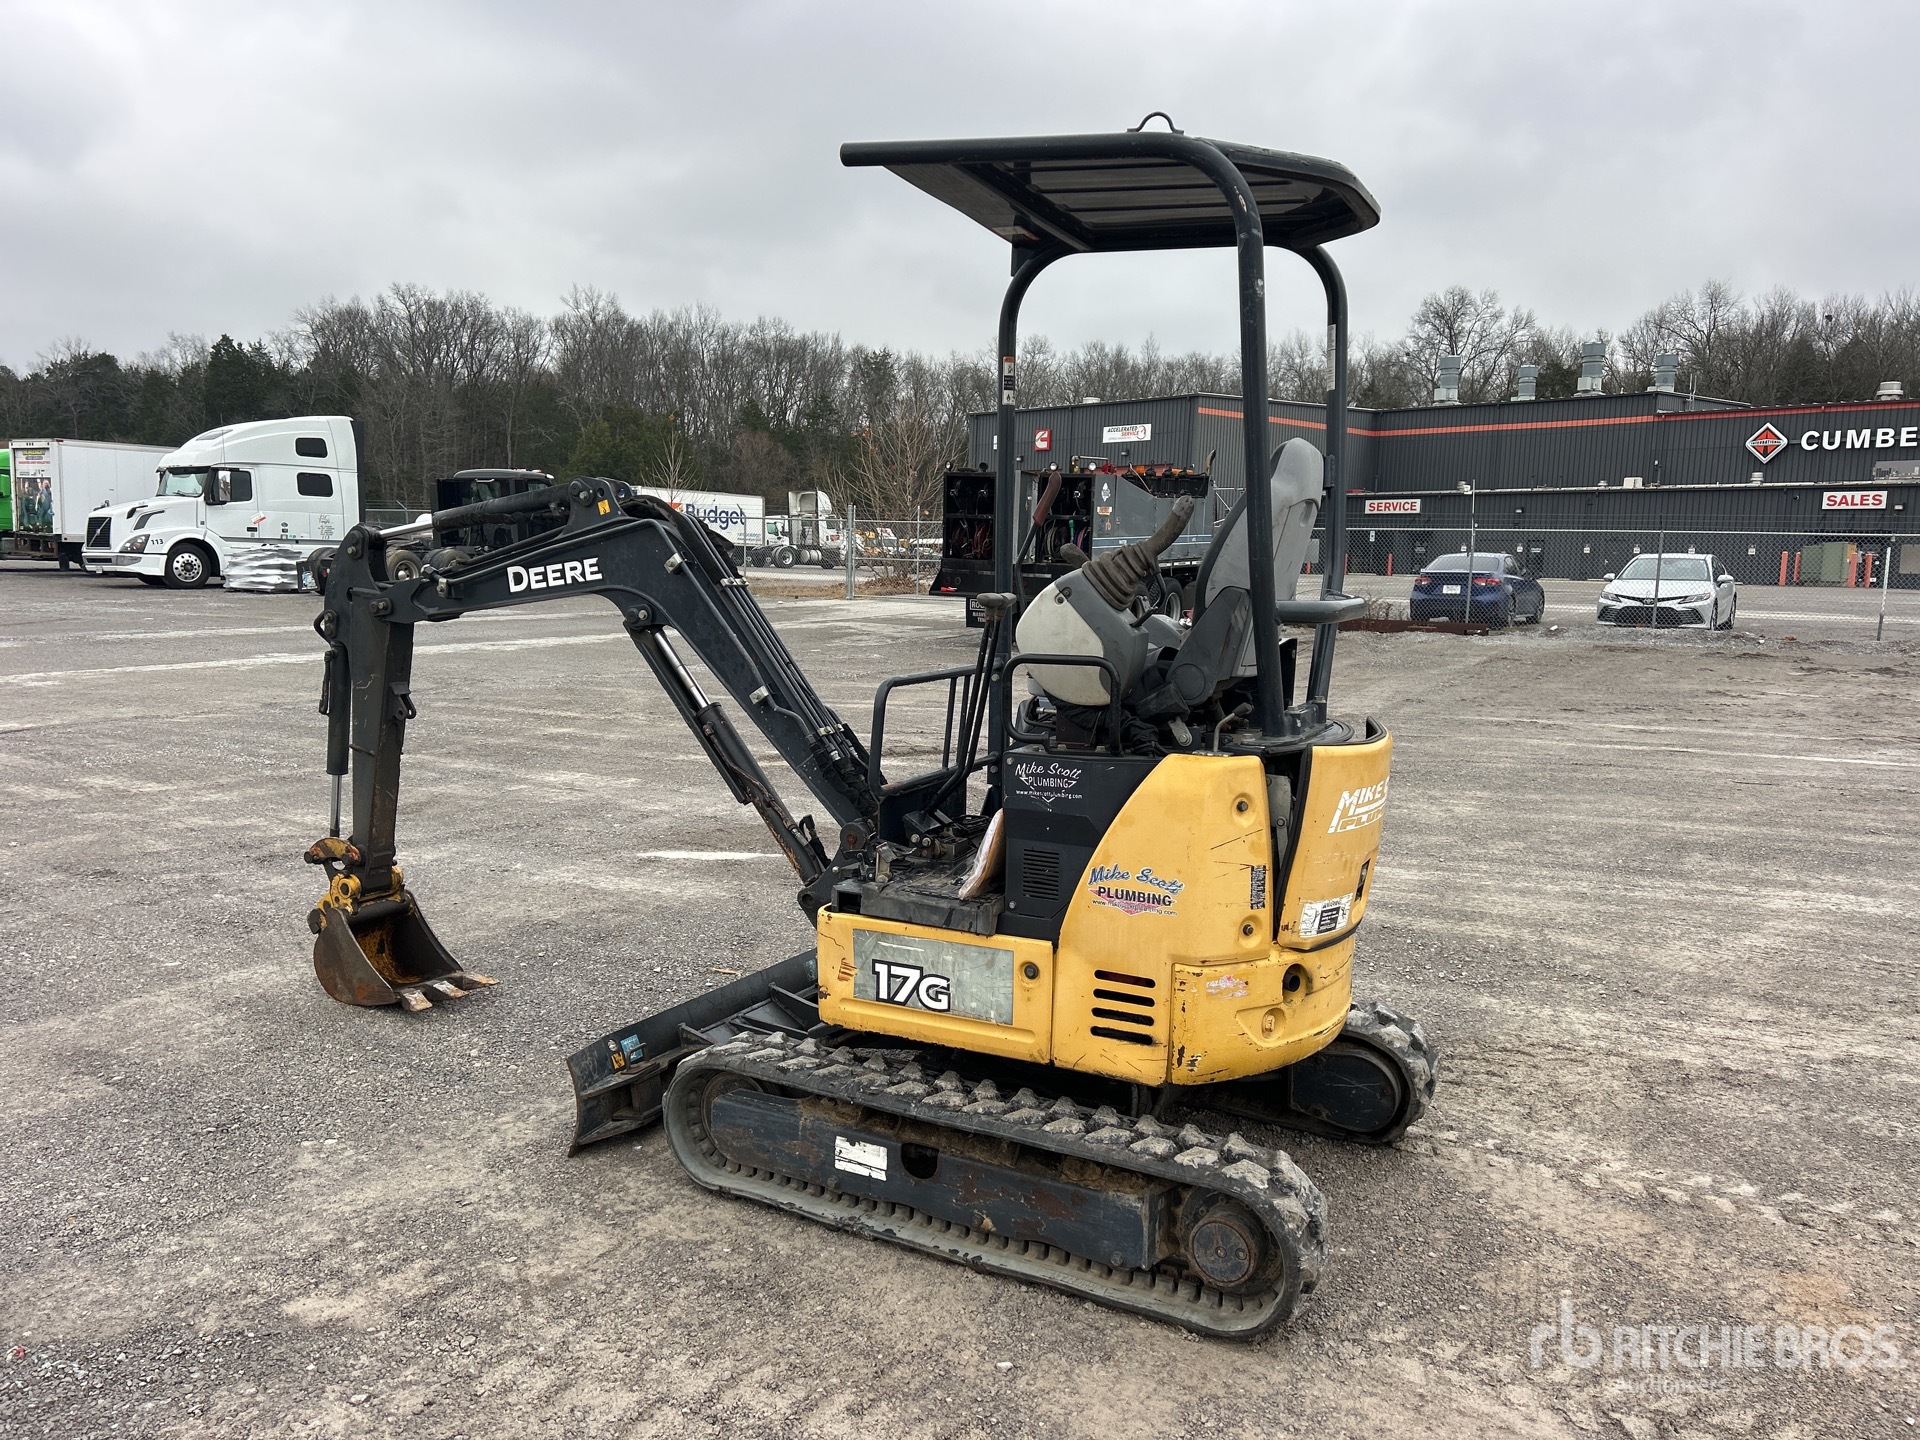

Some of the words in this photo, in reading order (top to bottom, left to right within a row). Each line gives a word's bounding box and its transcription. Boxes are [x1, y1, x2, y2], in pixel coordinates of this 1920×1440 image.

[1800, 426, 1918, 451] CUMBE
[1368, 501, 1418, 512] SERVICE
[1826, 494, 1883, 507] SALES
[506, 557, 603, 593] DEERE
[1014, 761, 1045, 776] Mike
[1047, 762, 1082, 780] Scott
[1028, 776, 1069, 789] PLUMBING
[1327, 780, 1384, 834] MIKE
[1087, 863, 1131, 886] Mike
[1136, 867, 1185, 895] Scott
[1097, 885, 1172, 907] PLUMBING
[872, 958, 952, 1013] 17G
